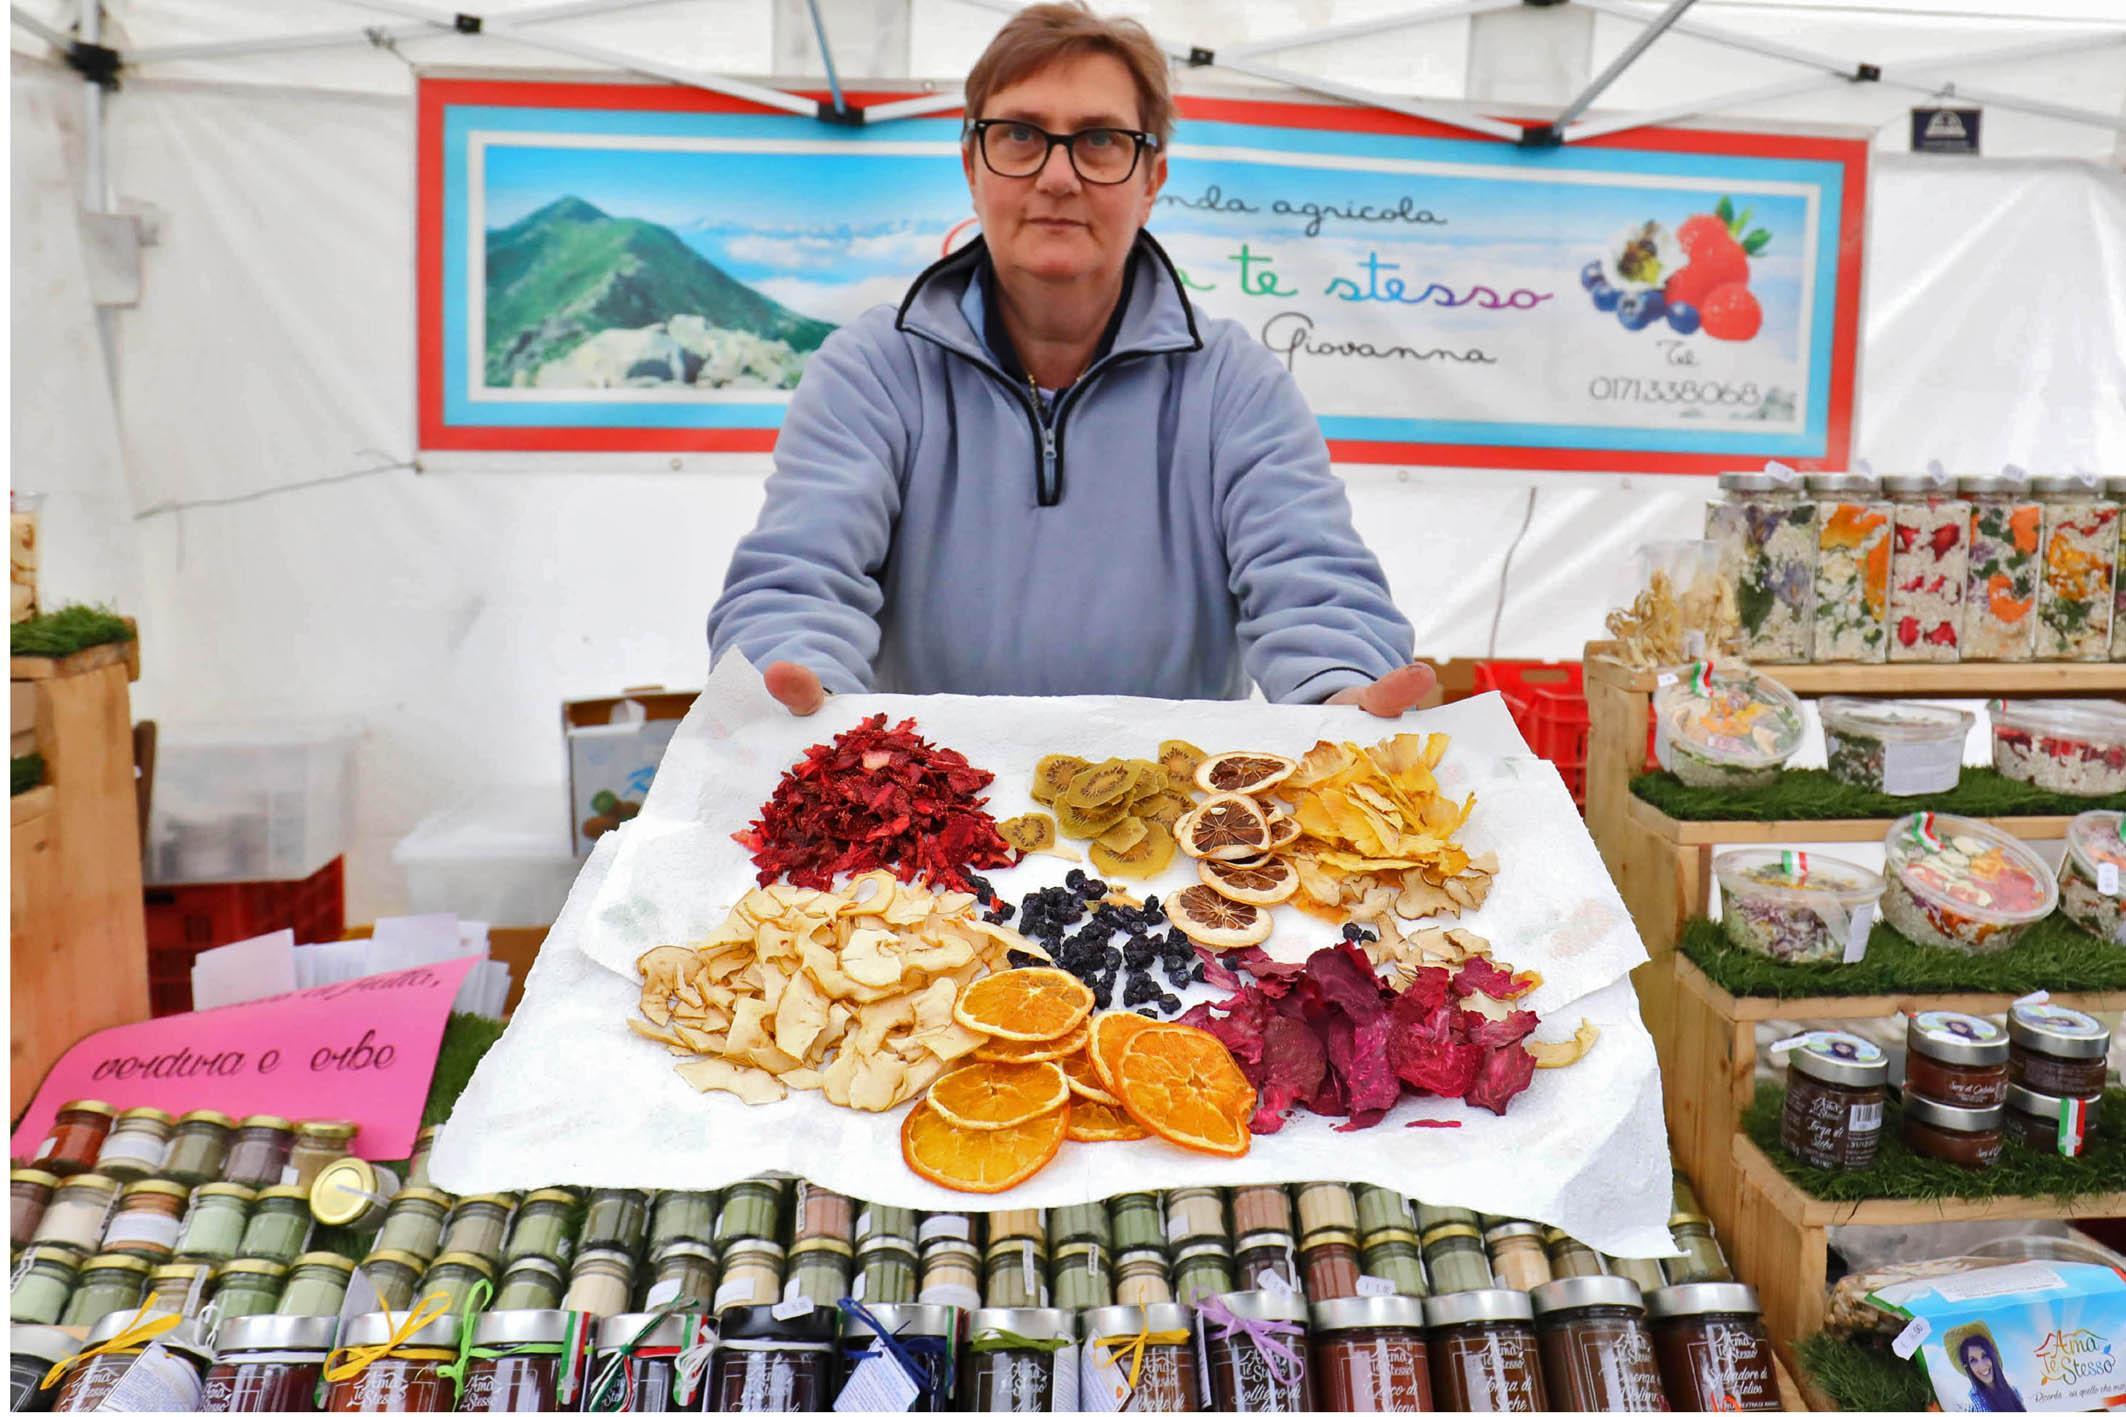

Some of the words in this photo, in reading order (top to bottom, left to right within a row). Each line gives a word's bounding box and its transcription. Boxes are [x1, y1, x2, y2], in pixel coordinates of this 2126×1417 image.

[1272, 196, 1448, 238] agricola
[1228, 243, 1299, 297] te
[1323, 251, 1554, 310] stesso
[1261, 311, 1500, 371] Giovanna
[92, 1046, 247, 1081] verdura
[257, 1049, 284, 1074] e
[310, 1028, 396, 1072] erbe
[2051, 1329, 2099, 1357] Ama
[2036, 1353, 2057, 1375] Te
[2061, 1356, 2113, 1385] Stesso
